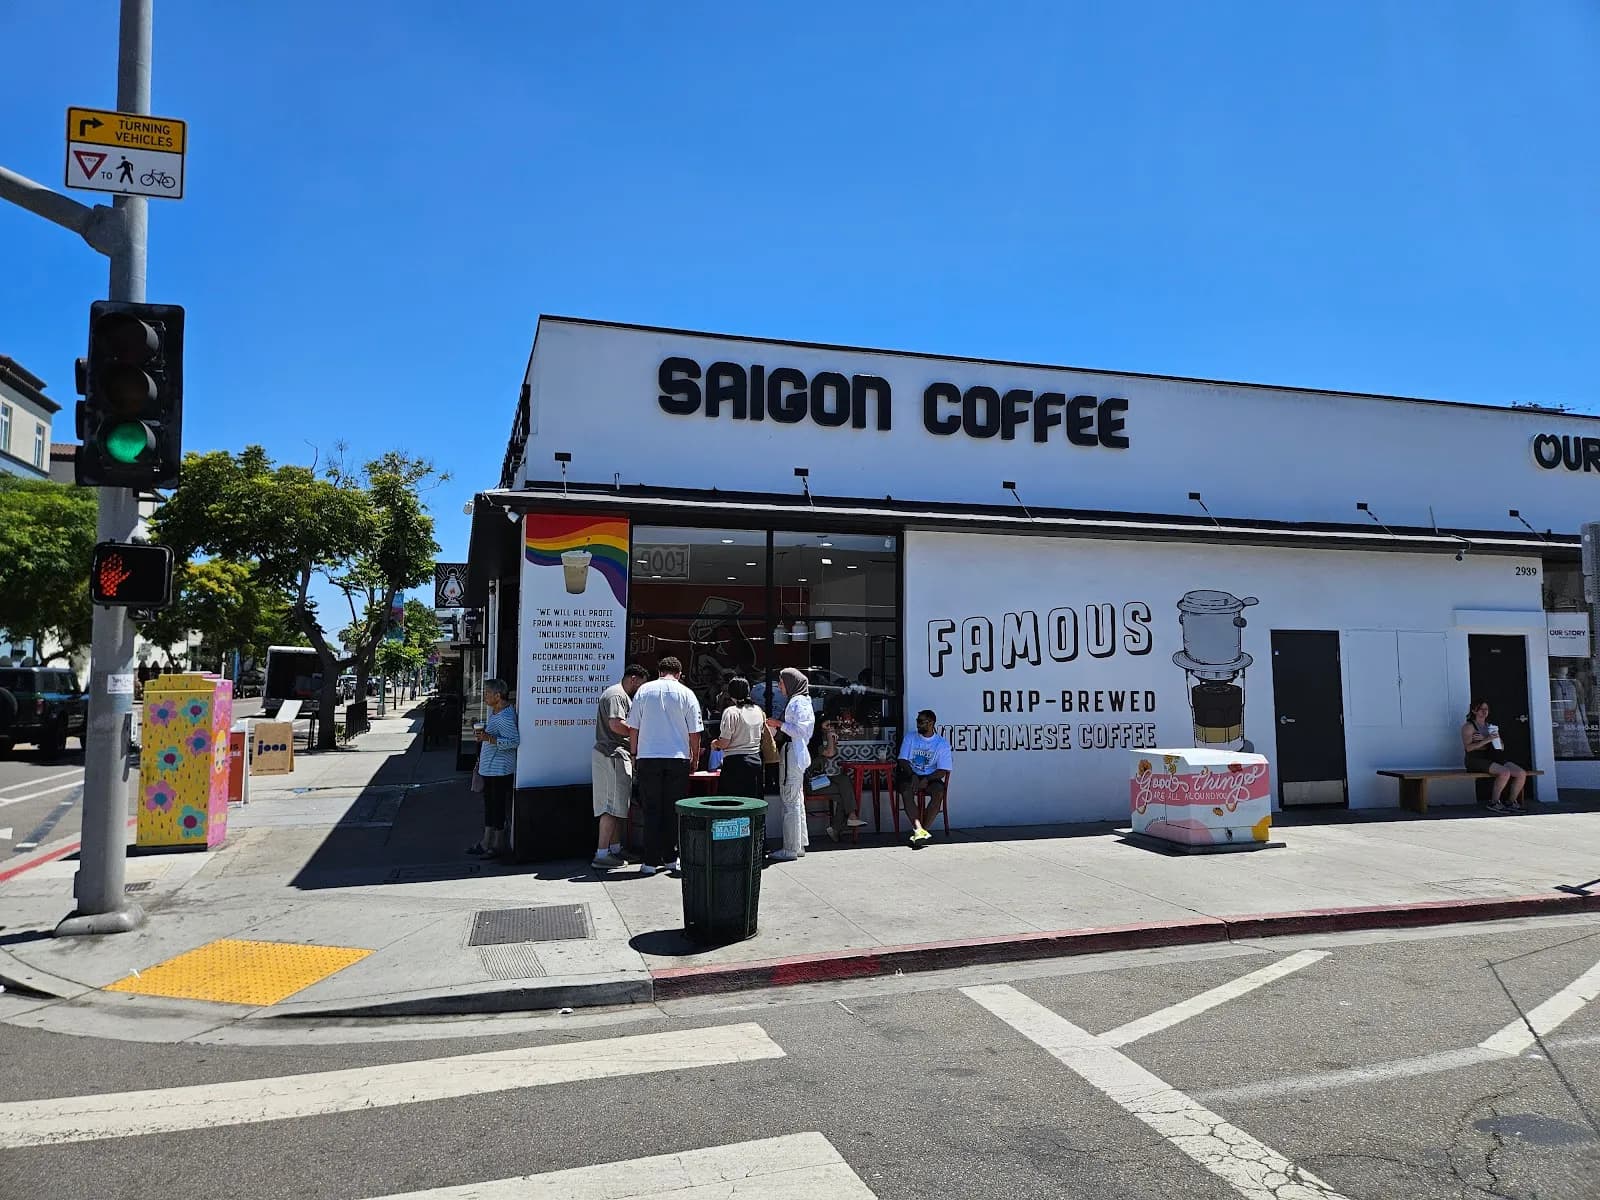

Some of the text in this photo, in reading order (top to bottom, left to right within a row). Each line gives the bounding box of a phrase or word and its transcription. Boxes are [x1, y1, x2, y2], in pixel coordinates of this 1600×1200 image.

[118, 119, 171, 136] TURNING
[115, 131, 174, 148] VEHICLES
[101, 171, 113, 180] TO
[657, 356, 1130, 449] SAIGON COFFEE
[1533, 433, 1600, 473] OUR
[1515, 566, 1537, 577] 2939
[553, 608, 571, 616] WILL
[573, 609, 586, 617] ALL
[588, 609, 613, 617] PROFIT
[532, 619, 553, 628] FROM
[563, 620, 582, 628] MORE
[539, 630, 576, 638] INCLUSIVE
[927, 601, 1153, 678] FAMOUS
[598, 653, 615, 661] EVEN
[542, 663, 589, 671] CELEBRATING
[588, 674, 611, 682] WHILE
[531, 686, 562, 694] PULLING
[564, 686, 599, 694] TOGETHER
[536, 697, 600, 705] THE COMMON GOO
[982, 690, 1156, 713] DRIP-BREWED
[534, 719, 552, 727] RUTH
[554, 719, 575, 727] BADER
[1077, 722, 1157, 750] COFFEE
[1136, 769, 1190, 804] Good
[1152, 791, 1165, 801] ARE
[1168, 791, 1180, 801] ALL
